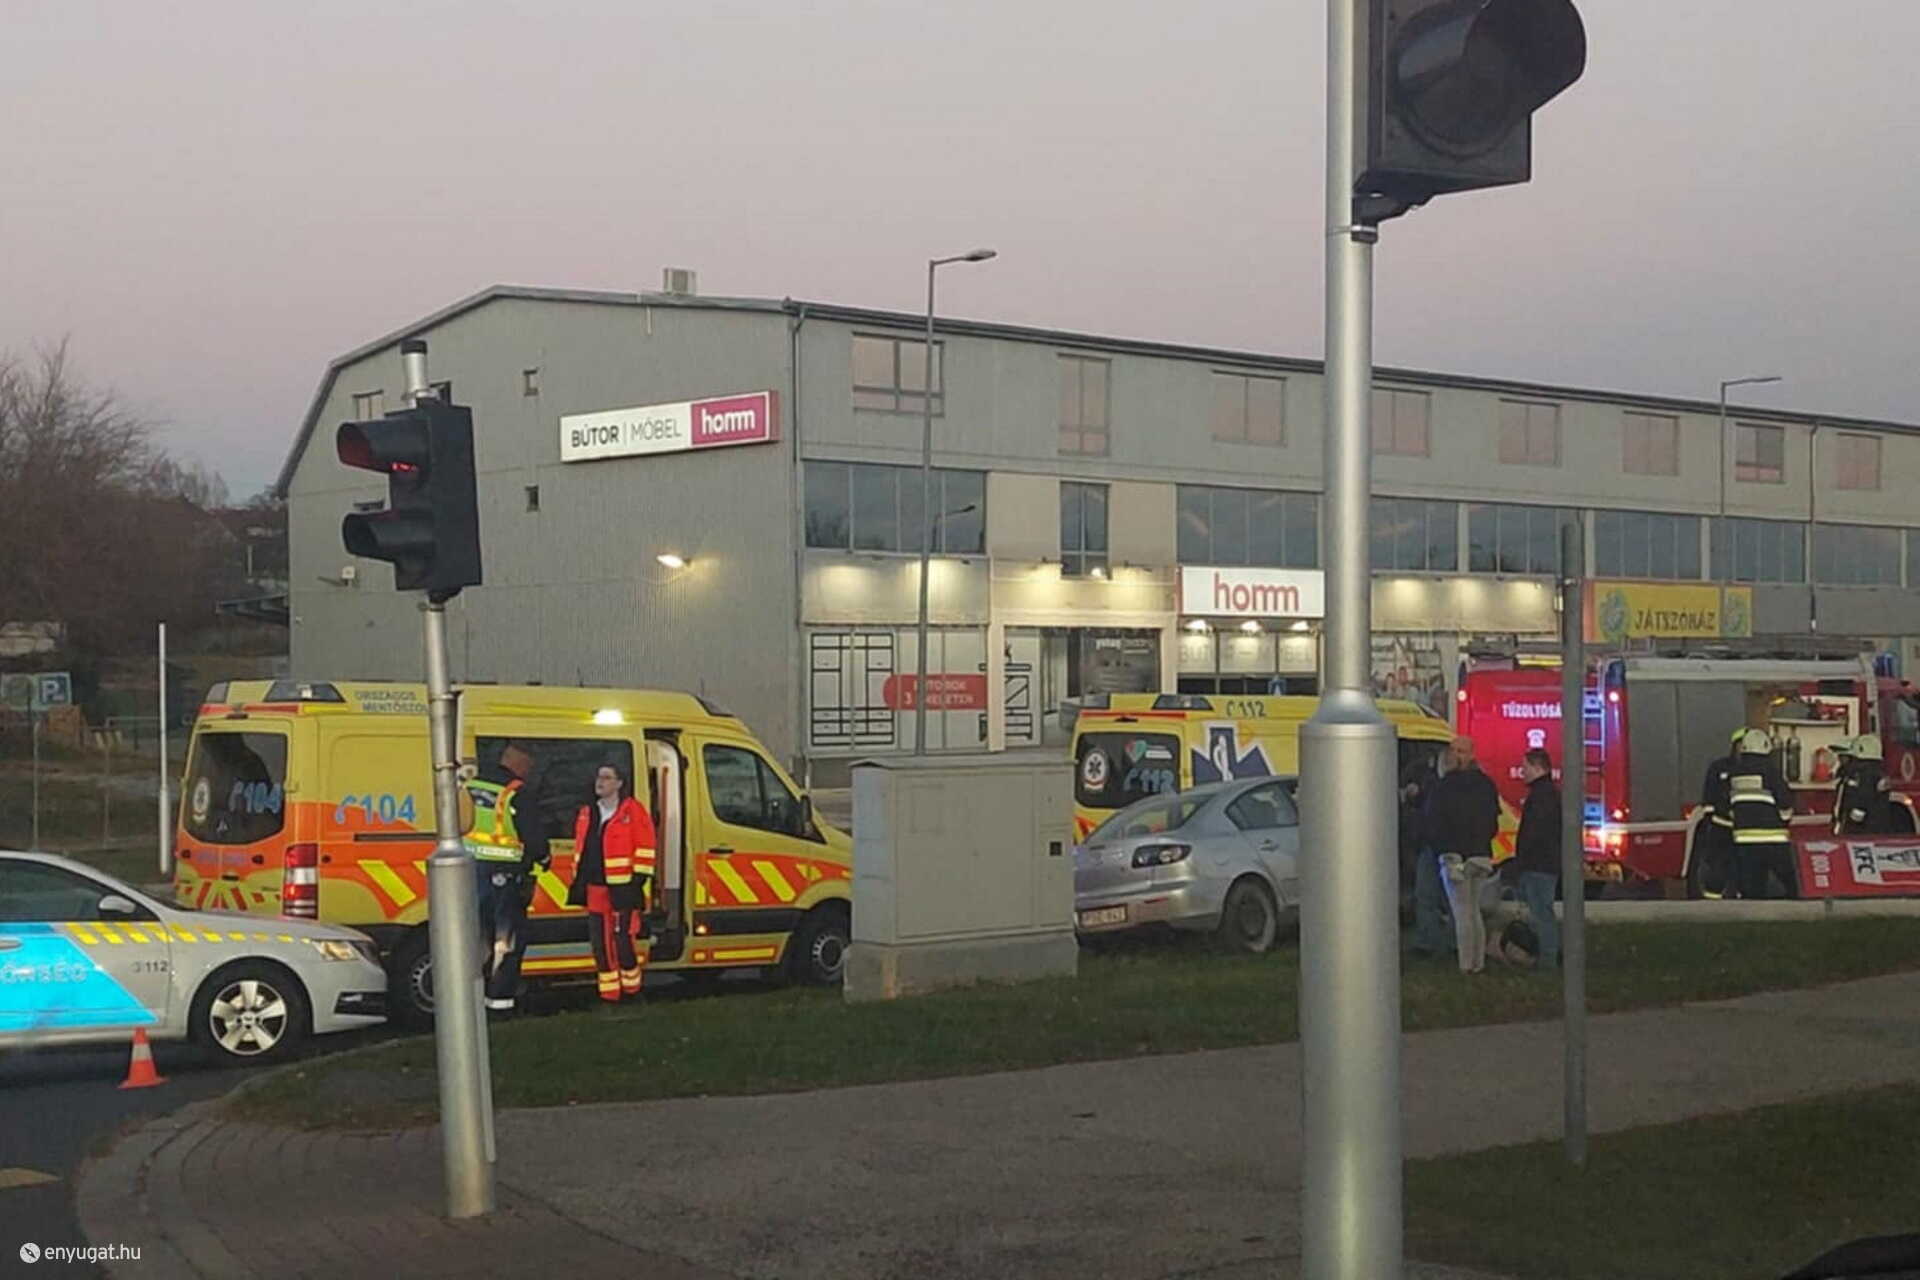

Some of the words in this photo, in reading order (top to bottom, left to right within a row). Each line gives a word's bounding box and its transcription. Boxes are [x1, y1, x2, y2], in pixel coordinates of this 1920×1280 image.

[571, 424, 619, 447] BÚTOR
[630, 417, 683, 441] MÖBEL
[701, 408, 756, 435] homm
[1214, 572, 1300, 612] homm
[1635, 606, 1716, 631] JÁTSZÓHÁZ
[1239, 700, 1267, 718] 112
[1501, 701, 1562, 718] TŰZOLTÓSÁ
[361, 793, 417, 824] 104
[1852, 846, 1876, 875] KFC
[145, 961, 169, 973] 112
